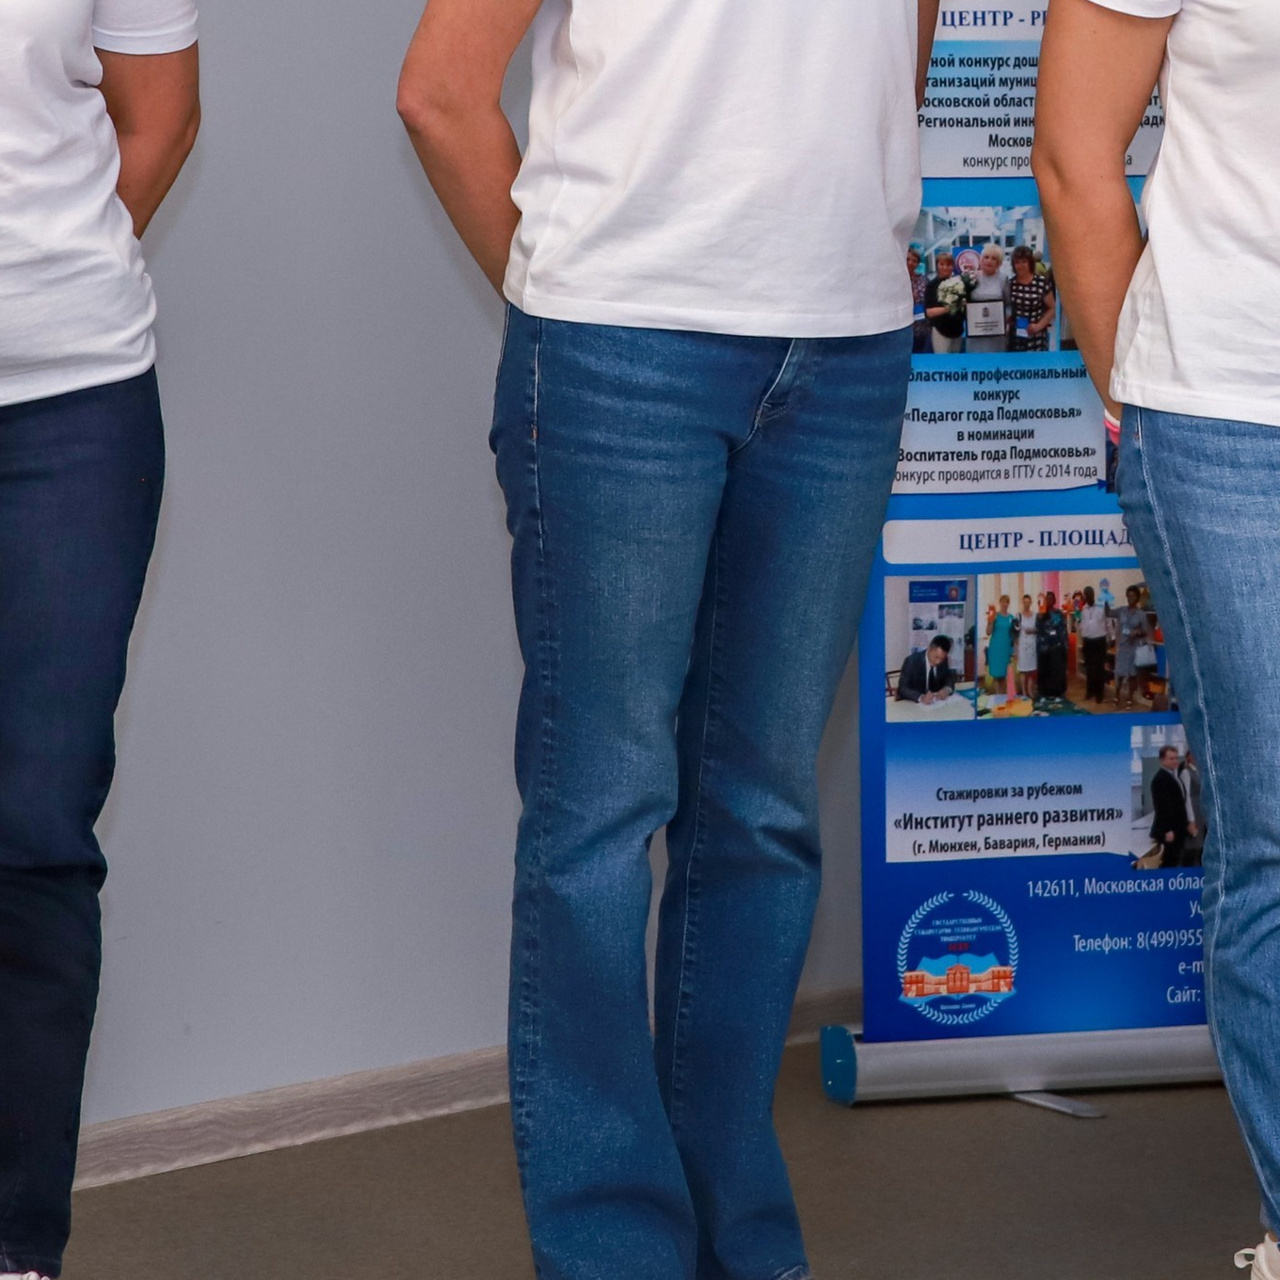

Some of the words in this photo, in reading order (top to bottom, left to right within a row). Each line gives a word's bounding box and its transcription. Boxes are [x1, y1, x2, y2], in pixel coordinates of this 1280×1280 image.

[941, 10, 1013, 29] ЦЕНТР
[958, 56, 1010, 71] конкурс
[917, 114, 1010, 128] Региональной
[963, 156, 1008, 171] конкурс
[971, 365, 1087, 387] профессиональный
[973, 389, 1020, 404] конкурс
[904, 407, 964, 424] «Педагог
[967, 410, 994, 424] года
[997, 406, 1082, 423] Подмосковья»
[957, 431, 964, 441] в
[968, 429, 1035, 443] номинации
[981, 448, 1007, 463] года
[1010, 445, 1097, 461] Подмосковья»
[938, 468, 1001, 484] проводится
[1004, 469, 1010, 479] в
[1012, 465, 1035, 480] ГГТУ
[1038, 468, 1043, 478] с
[1045, 464, 1071, 478] 2014
[1074, 465, 1098, 480] года
[959, 532, 1023, 551] ЦЕНТР
[936, 783, 1008, 803] Стажировки
[1011, 786, 1024, 797] за
[1026, 783, 1083, 801] рубежом
[894, 811, 974, 831] «Институт
[977, 810, 1039, 829] раннего
[1043, 807, 1123, 826] развития»
[929, 838, 981, 854] Мюнхен,
[984, 835, 1039, 852] Бавария,
[1042, 831, 1106, 849] Германия)
[1027, 879, 1080, 899] 142611,
[1084, 875, 1164, 896] Московская
[1073, 933, 1132, 954] Телефон:
[1167, 985, 1201, 1003] Сайт:
